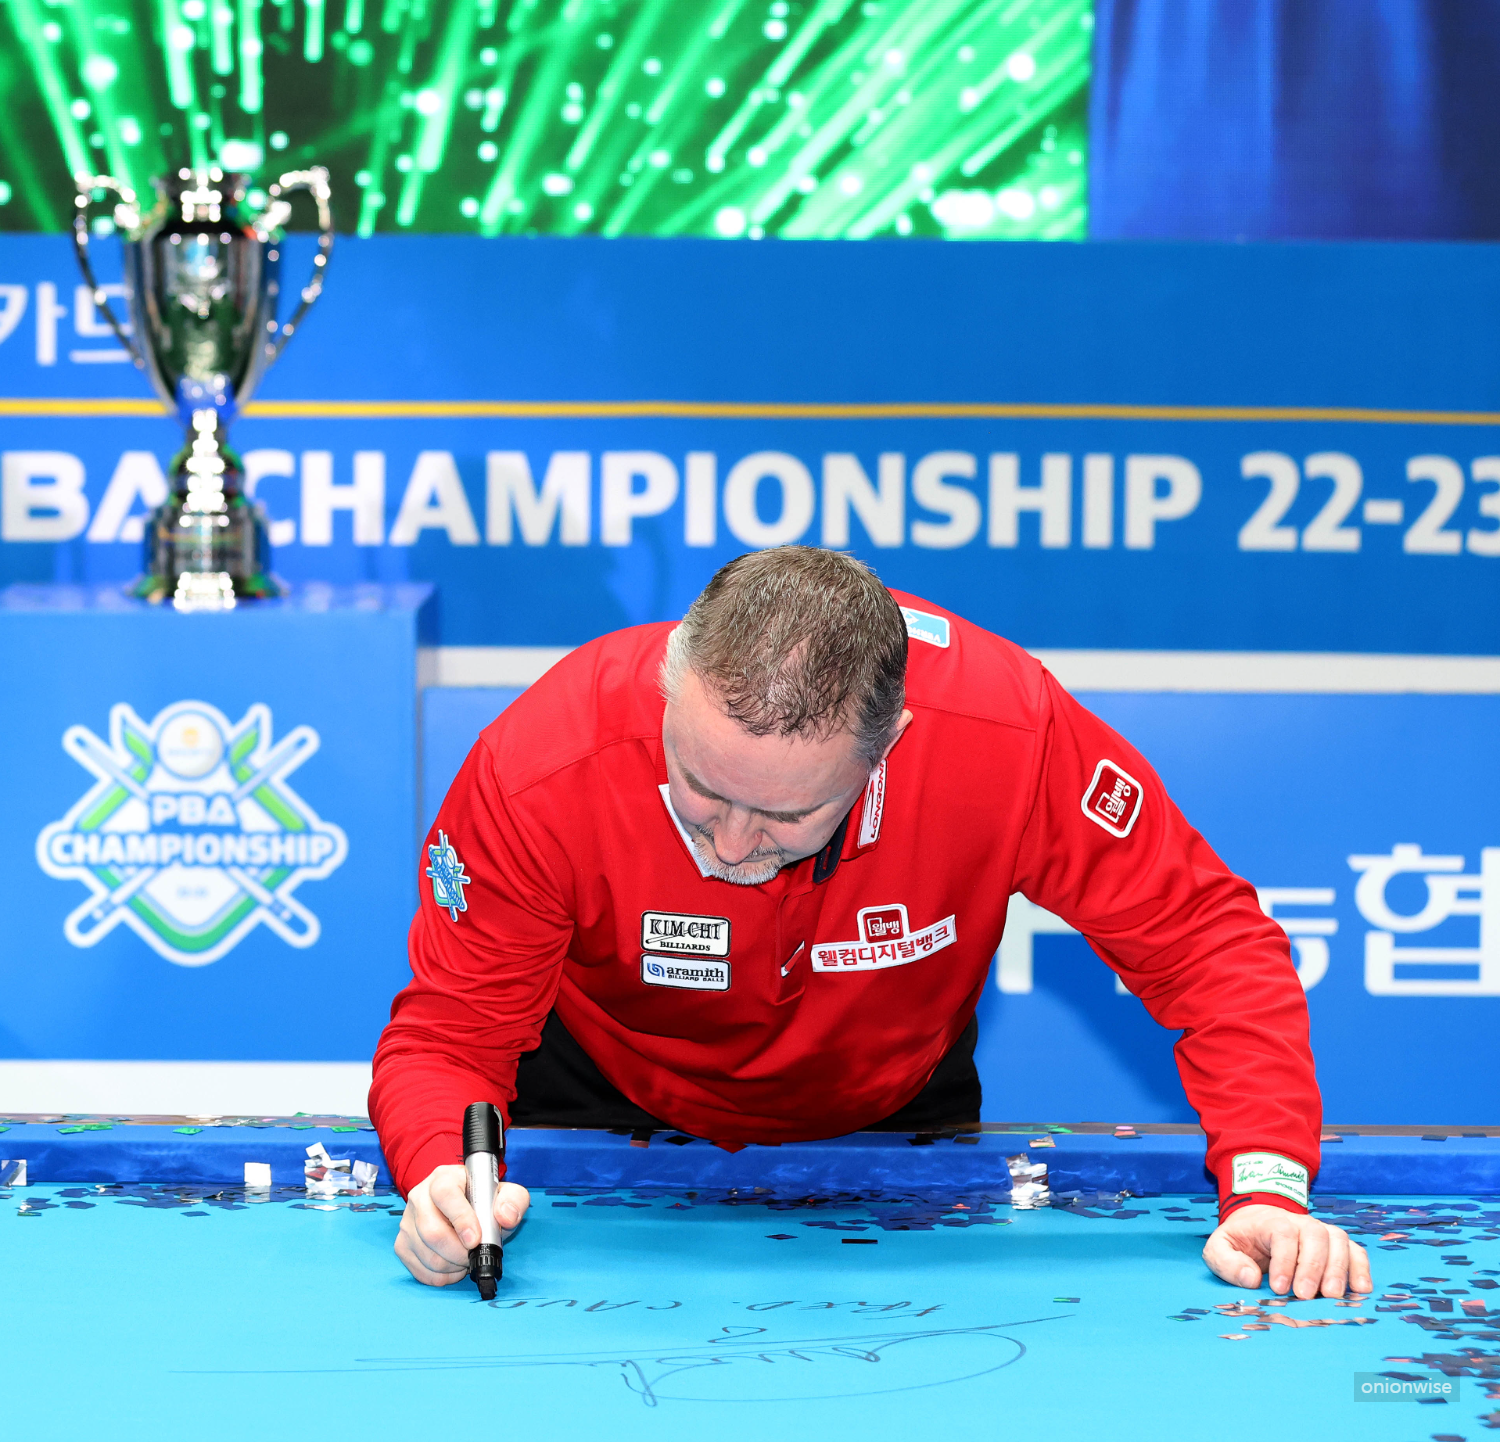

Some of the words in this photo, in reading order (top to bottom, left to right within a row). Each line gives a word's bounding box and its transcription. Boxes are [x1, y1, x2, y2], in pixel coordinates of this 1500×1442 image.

[243, 449, 1202, 548] CHAMPIONSHIP
[151, 795, 236, 826] PBA
[870, 762, 885, 839] LONGONI
[50, 832, 334, 866] CHAMPIONSHIP
[660, 941, 711, 951] BILLIARDS
[817, 925, 950, 967] 웰컴디지털뱅크
[666, 966, 724, 978] aramith
[668, 974, 700, 982] BILLIARD
